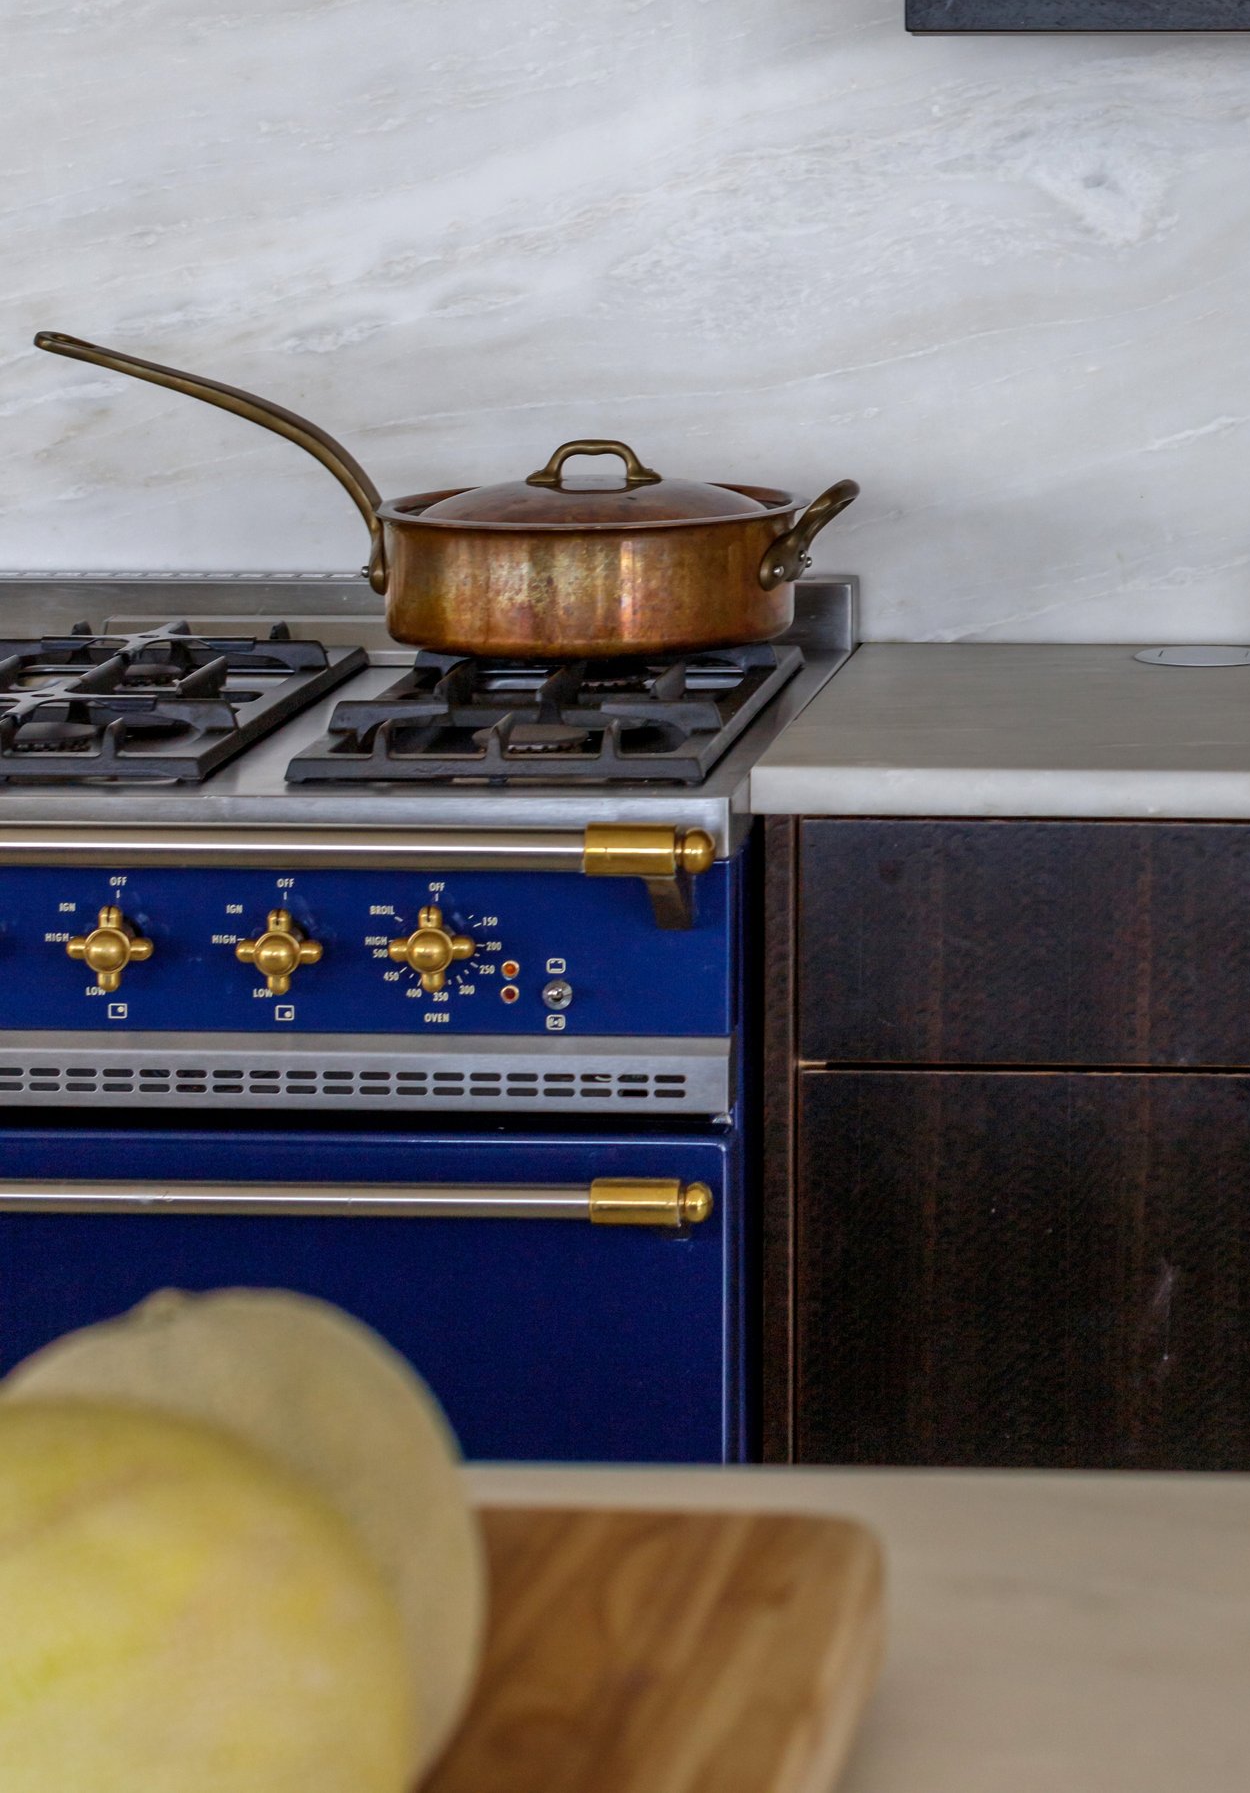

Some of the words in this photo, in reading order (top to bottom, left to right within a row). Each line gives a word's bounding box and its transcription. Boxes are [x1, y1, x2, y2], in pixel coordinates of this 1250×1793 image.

[109, 876, 127, 886] OFF
[277, 878, 294, 888] OFF
[429, 882, 445, 892] OFF
[59, 903, 76, 912] IGN
[226, 904, 243, 914] IGN
[370, 906, 395, 915] BROIL
[482, 917, 498, 926] 150
[45, 933, 69, 942] HIGH
[212, 935, 237, 944] HIGH
[365, 936, 387, 945] HIGH
[486, 942, 502, 951] 200
[373, 949, 388, 958] 500
[479, 965, 495, 975] 250
[383, 972, 399, 981] 450
[406, 989, 422, 998] 400
[459, 985, 475, 995] 300
[433, 992, 449, 1002] 350
[424, 1013, 450, 1023] OVEN
